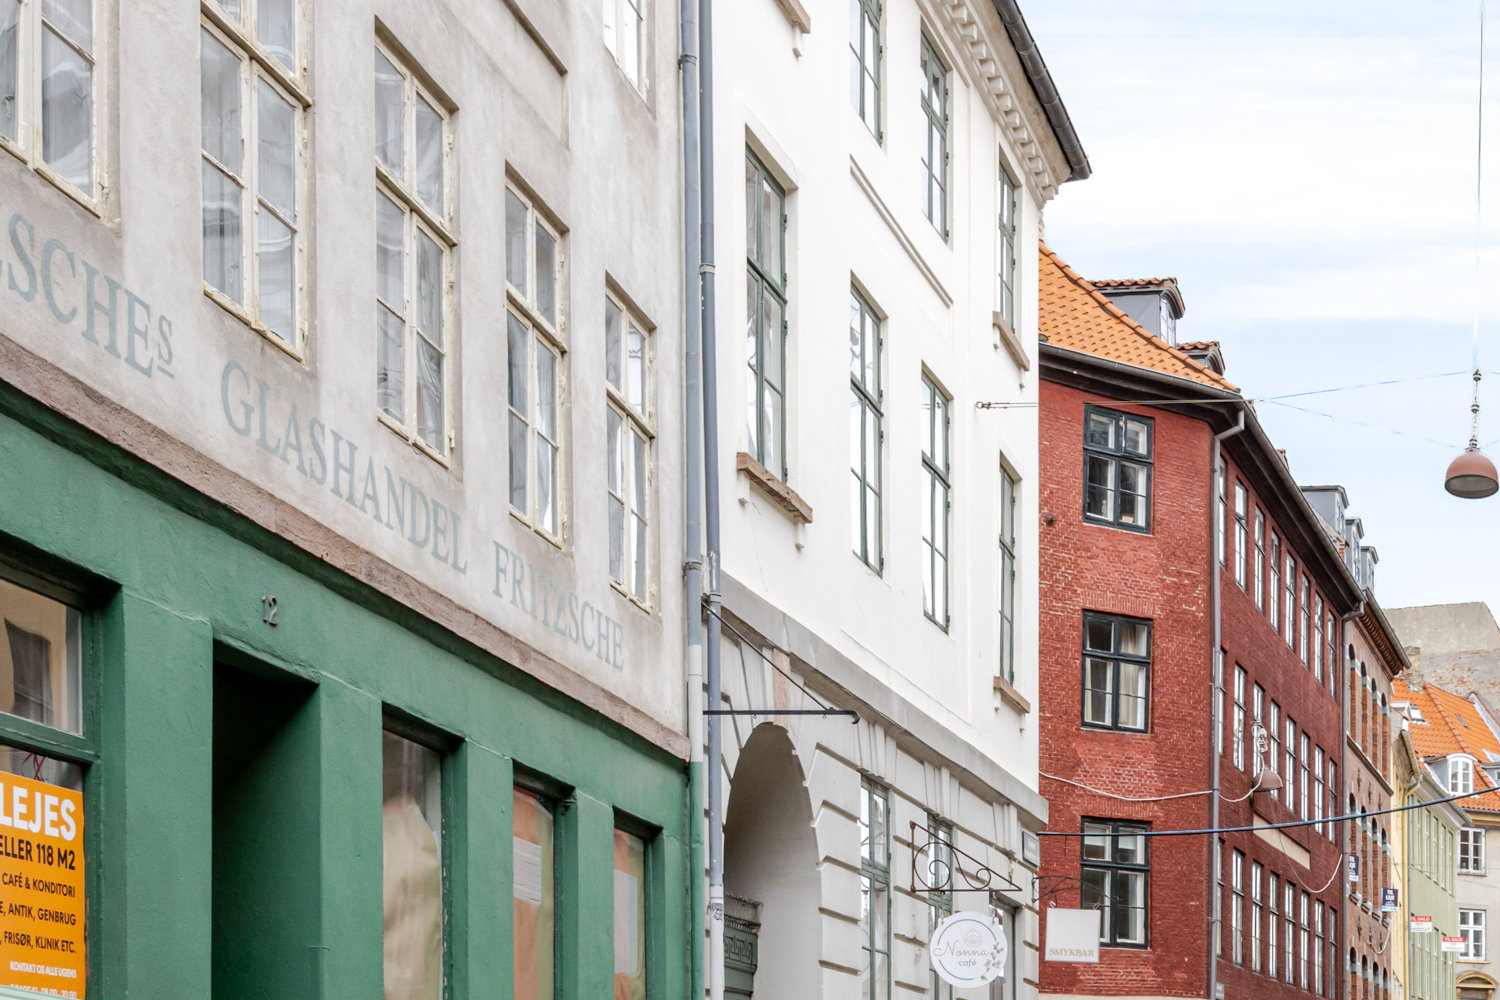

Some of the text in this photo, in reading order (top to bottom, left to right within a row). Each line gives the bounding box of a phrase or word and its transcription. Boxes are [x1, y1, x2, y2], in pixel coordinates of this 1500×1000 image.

[0, 213, 625, 672] SCHES GLASHANDEL FRITZSCHE
[261, 594, 279, 628] 12
[0, 782, 76, 842] LEJES
[36, 843, 54, 866] 118
[57, 847, 76, 870] M2
[2, 872, 76, 898] CAFÉ & KONDITORI
[8, 902, 35, 922] ANTIK,
[37, 907, 76, 926] GENBRUG
[4, 931, 77, 953] FRISØR, KLINIK ETC.
[933, 940, 991, 957] Nonna
[1049, 948, 1094, 957] SMYKBAR
[958, 959, 977, 967] café
